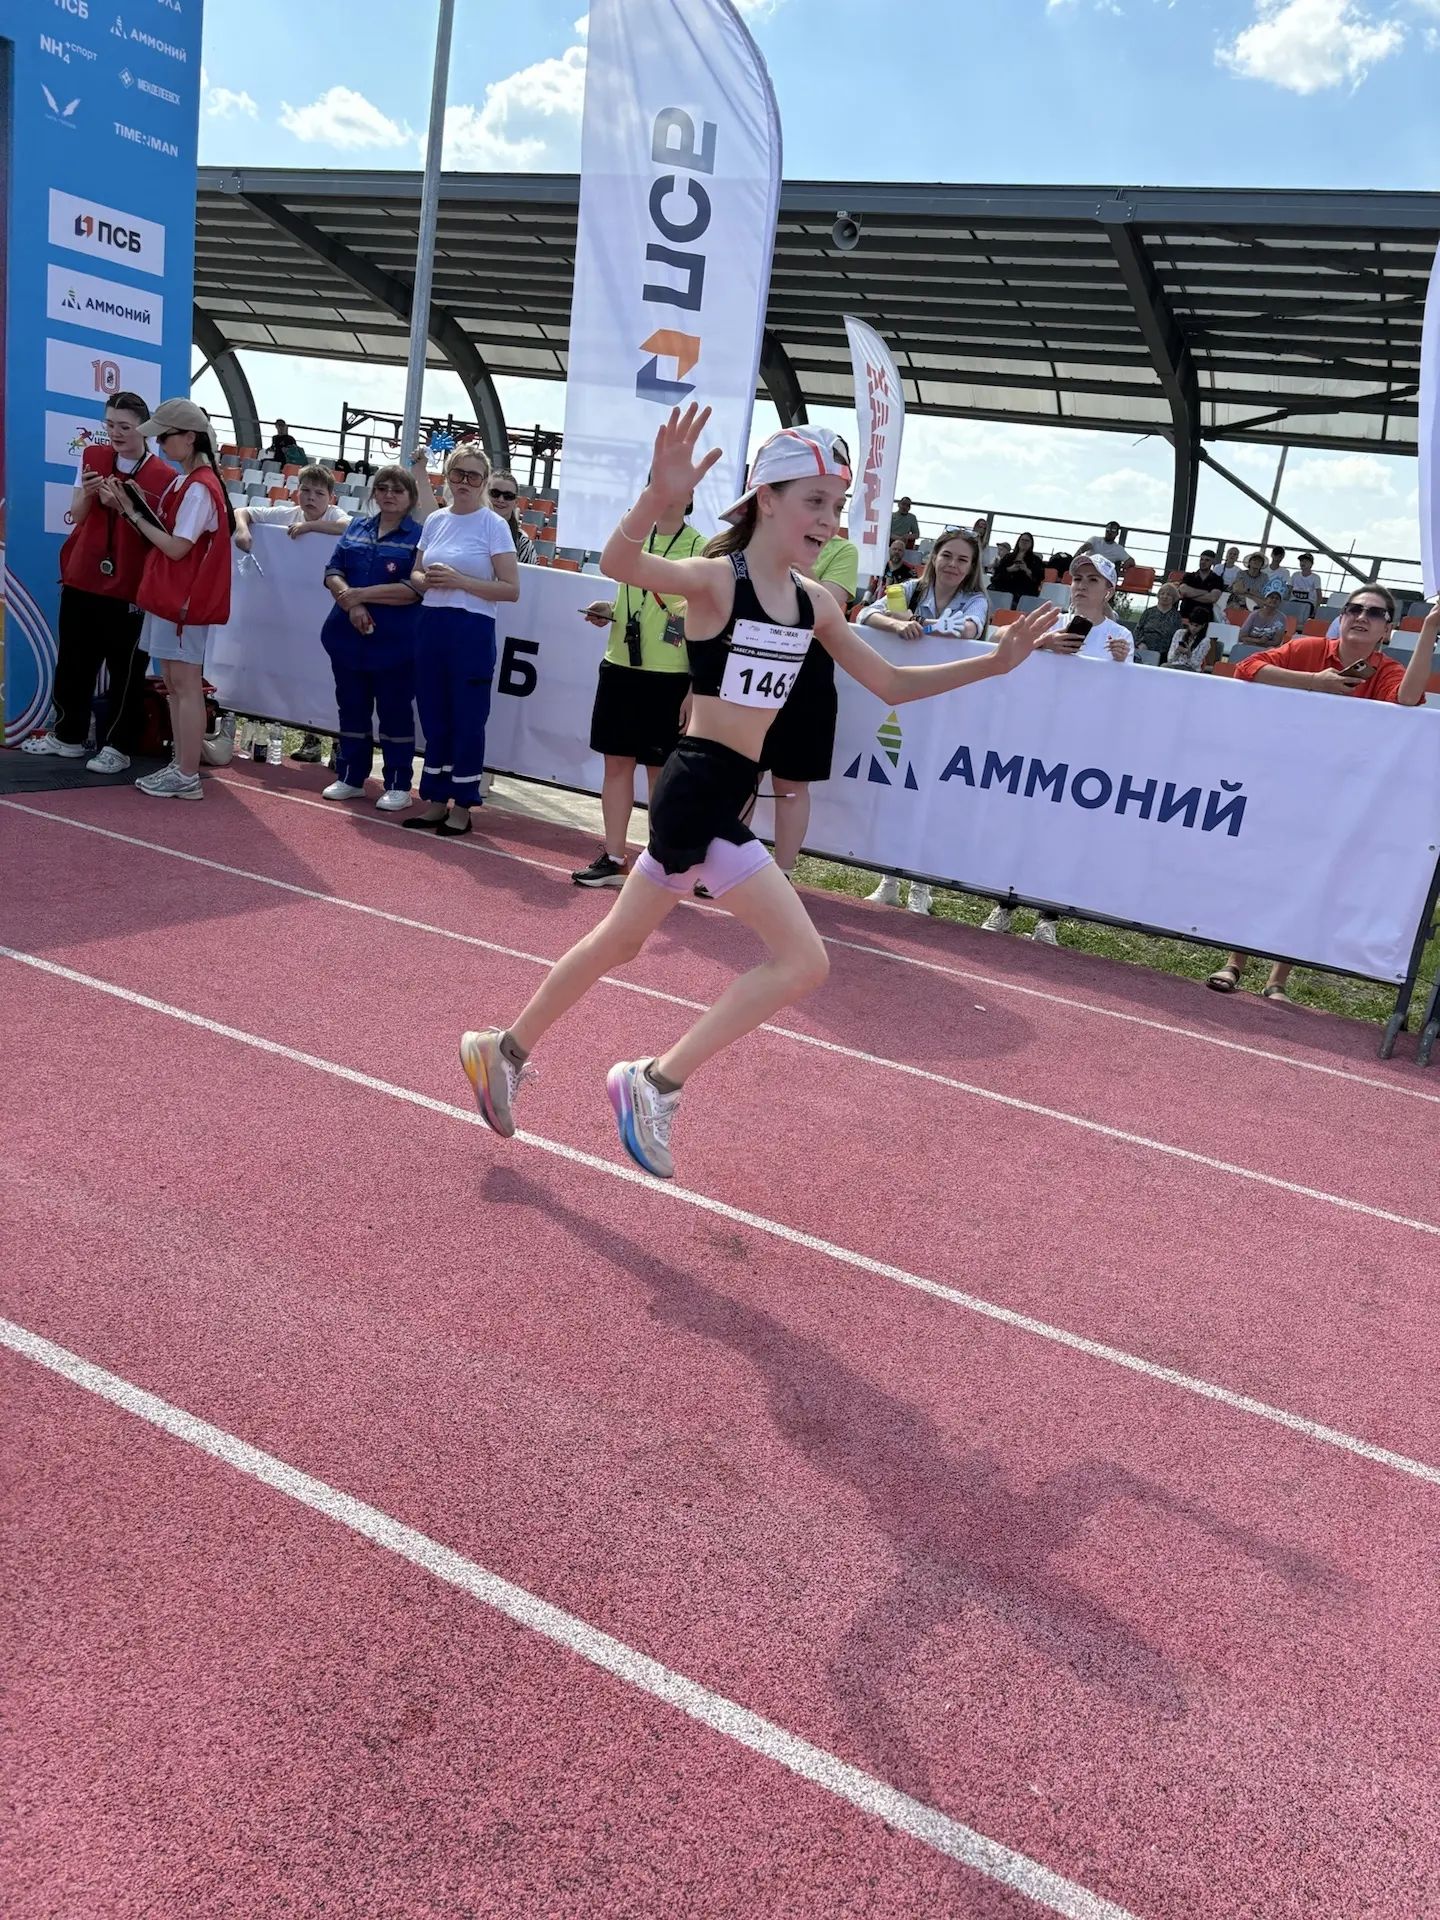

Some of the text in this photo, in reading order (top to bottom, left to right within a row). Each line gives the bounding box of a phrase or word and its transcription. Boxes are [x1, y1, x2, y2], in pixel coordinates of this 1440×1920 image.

[130, 28, 187, 63] АММОНИЙ
[98, 220, 141, 253] ПСБ
[85, 297, 151, 324] АММОНИЙ
[91, 359, 121, 395] 10
[939, 744, 1248, 838] АММОНИЙ
